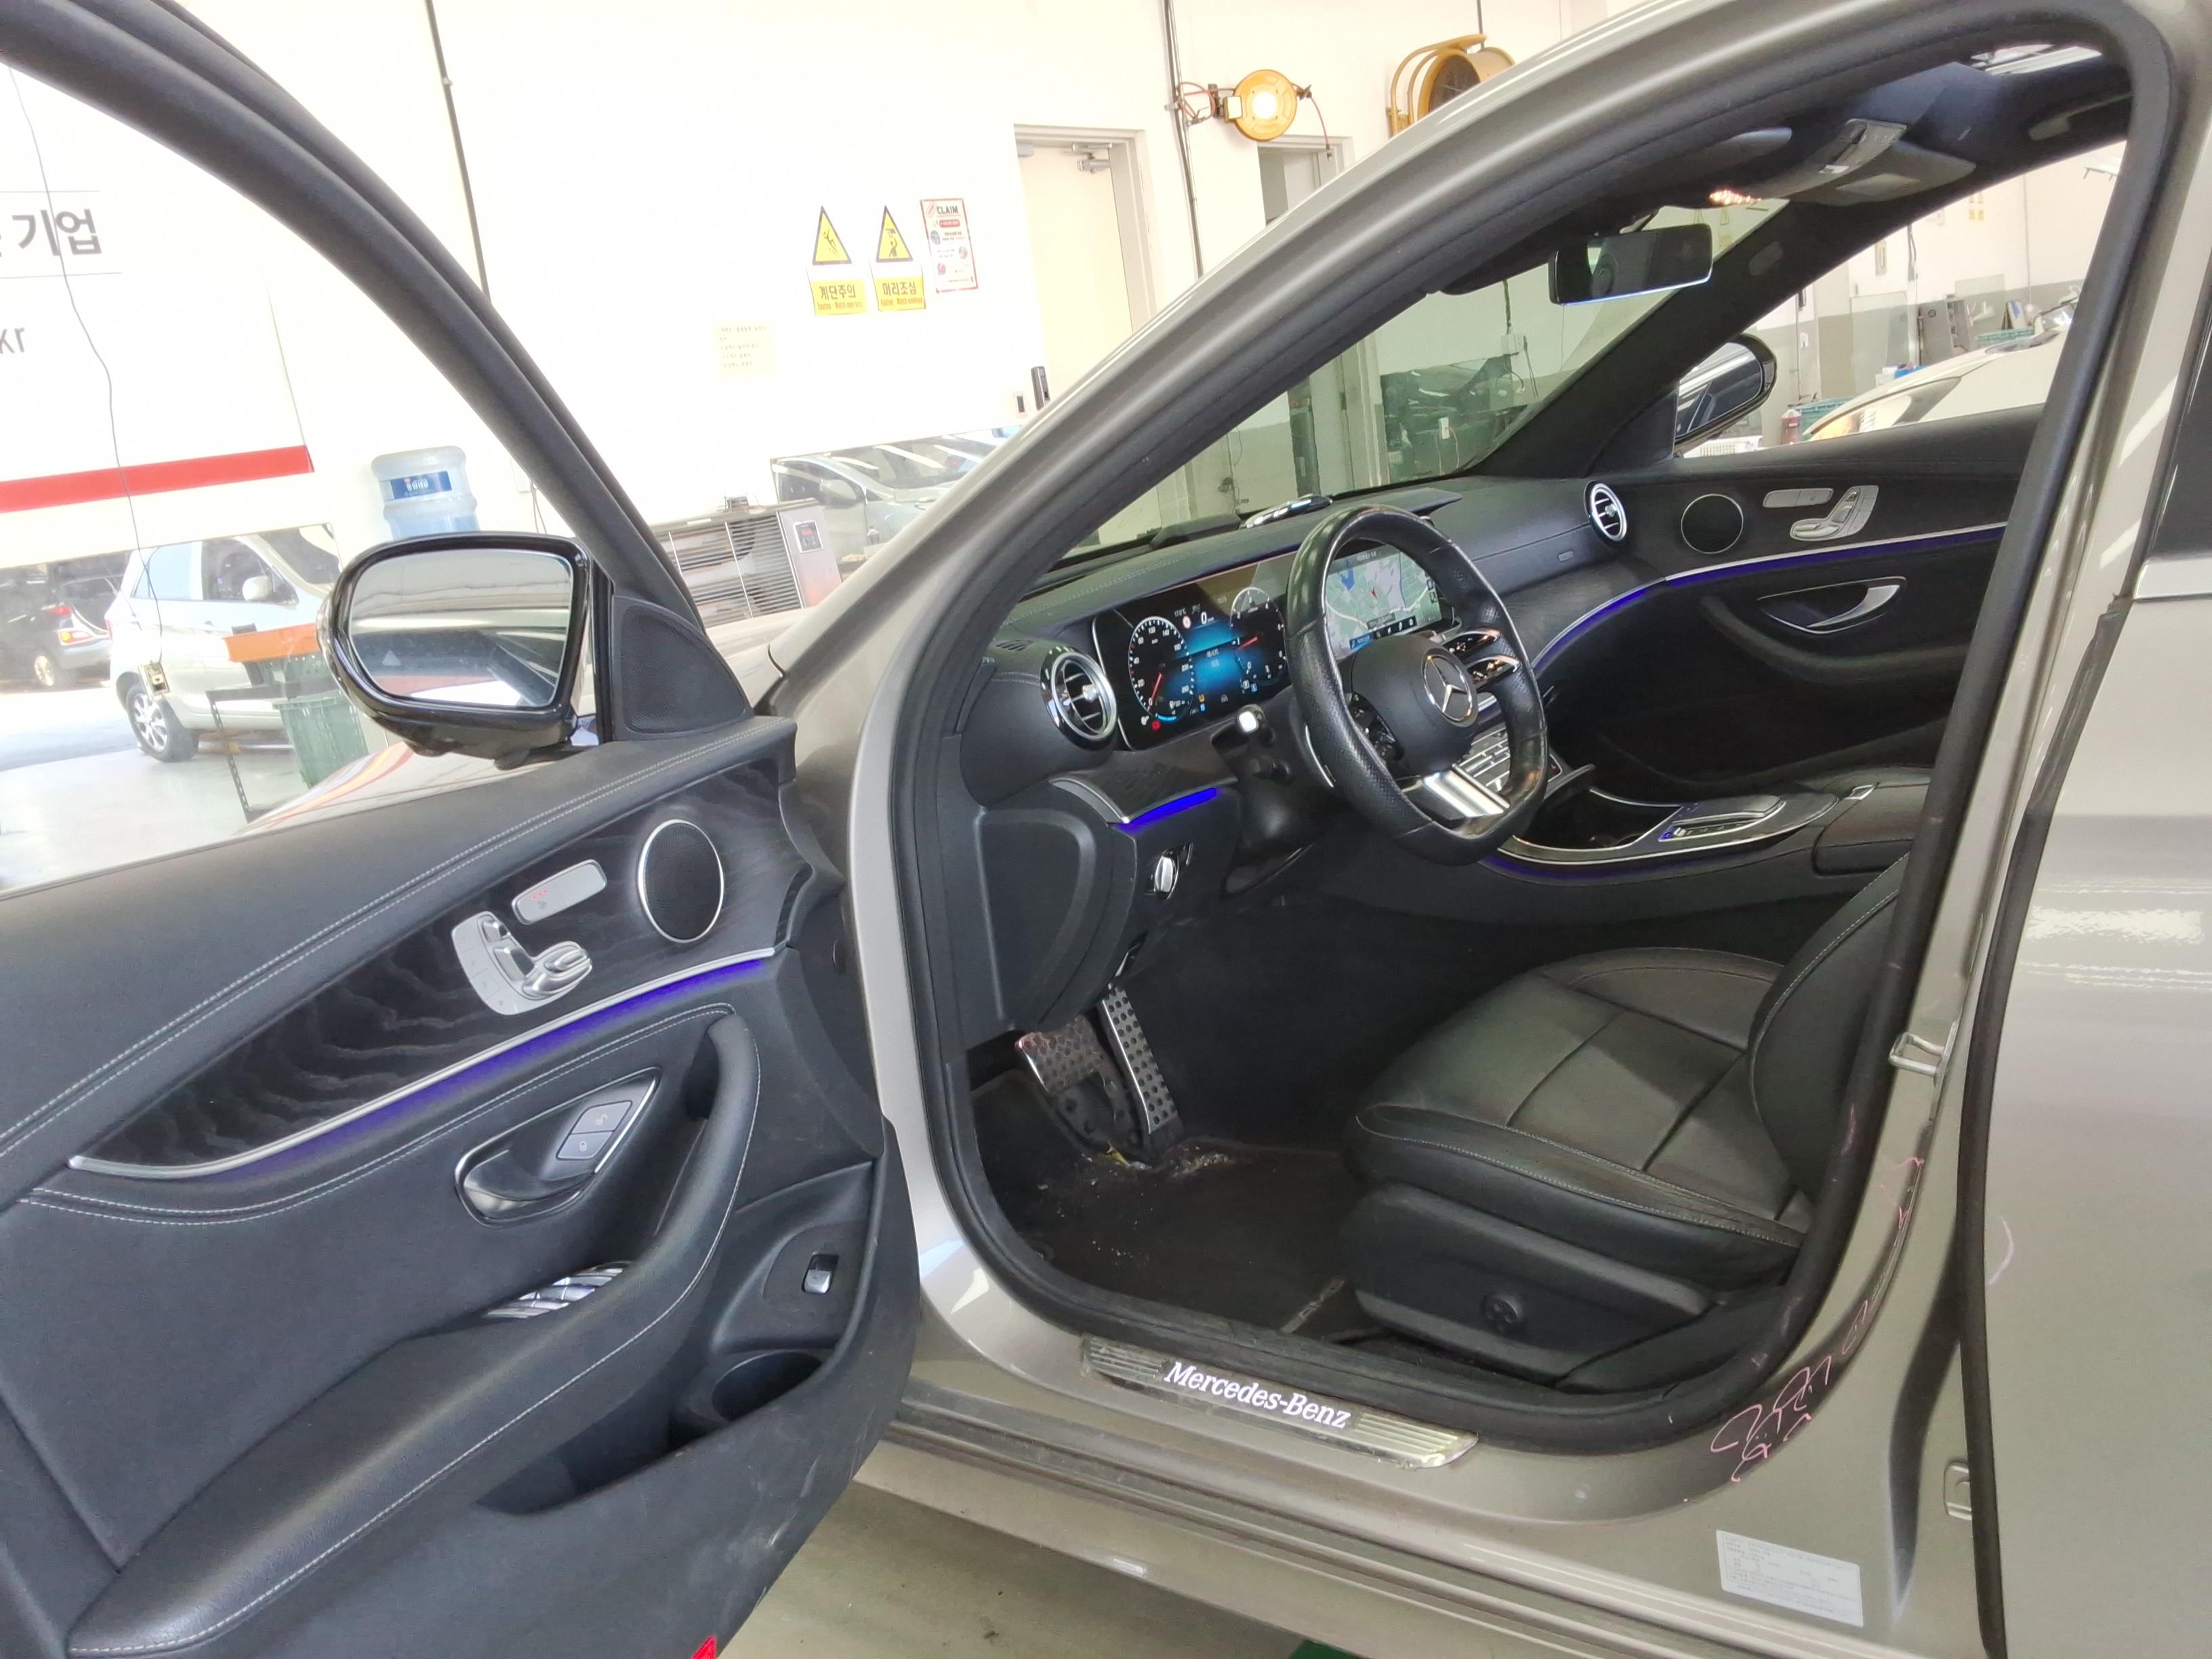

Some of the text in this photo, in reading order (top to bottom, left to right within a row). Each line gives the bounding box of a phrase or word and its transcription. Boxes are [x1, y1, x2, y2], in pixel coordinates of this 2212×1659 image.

[937, 205, 958, 215] CLAIM
[12, 209, 102, 256] 기업
[819, 284, 856, 300] 계단주의
[882, 281, 917, 296] 머리조심
[1201, 612, 1207, 625] 0
[1247, 661, 1251, 670] 0
[1138, 679, 1144, 687] 20
[1148, 697, 1153, 705] 0
[1164, 1361, 1351, 1429] Mercedes-Benz
